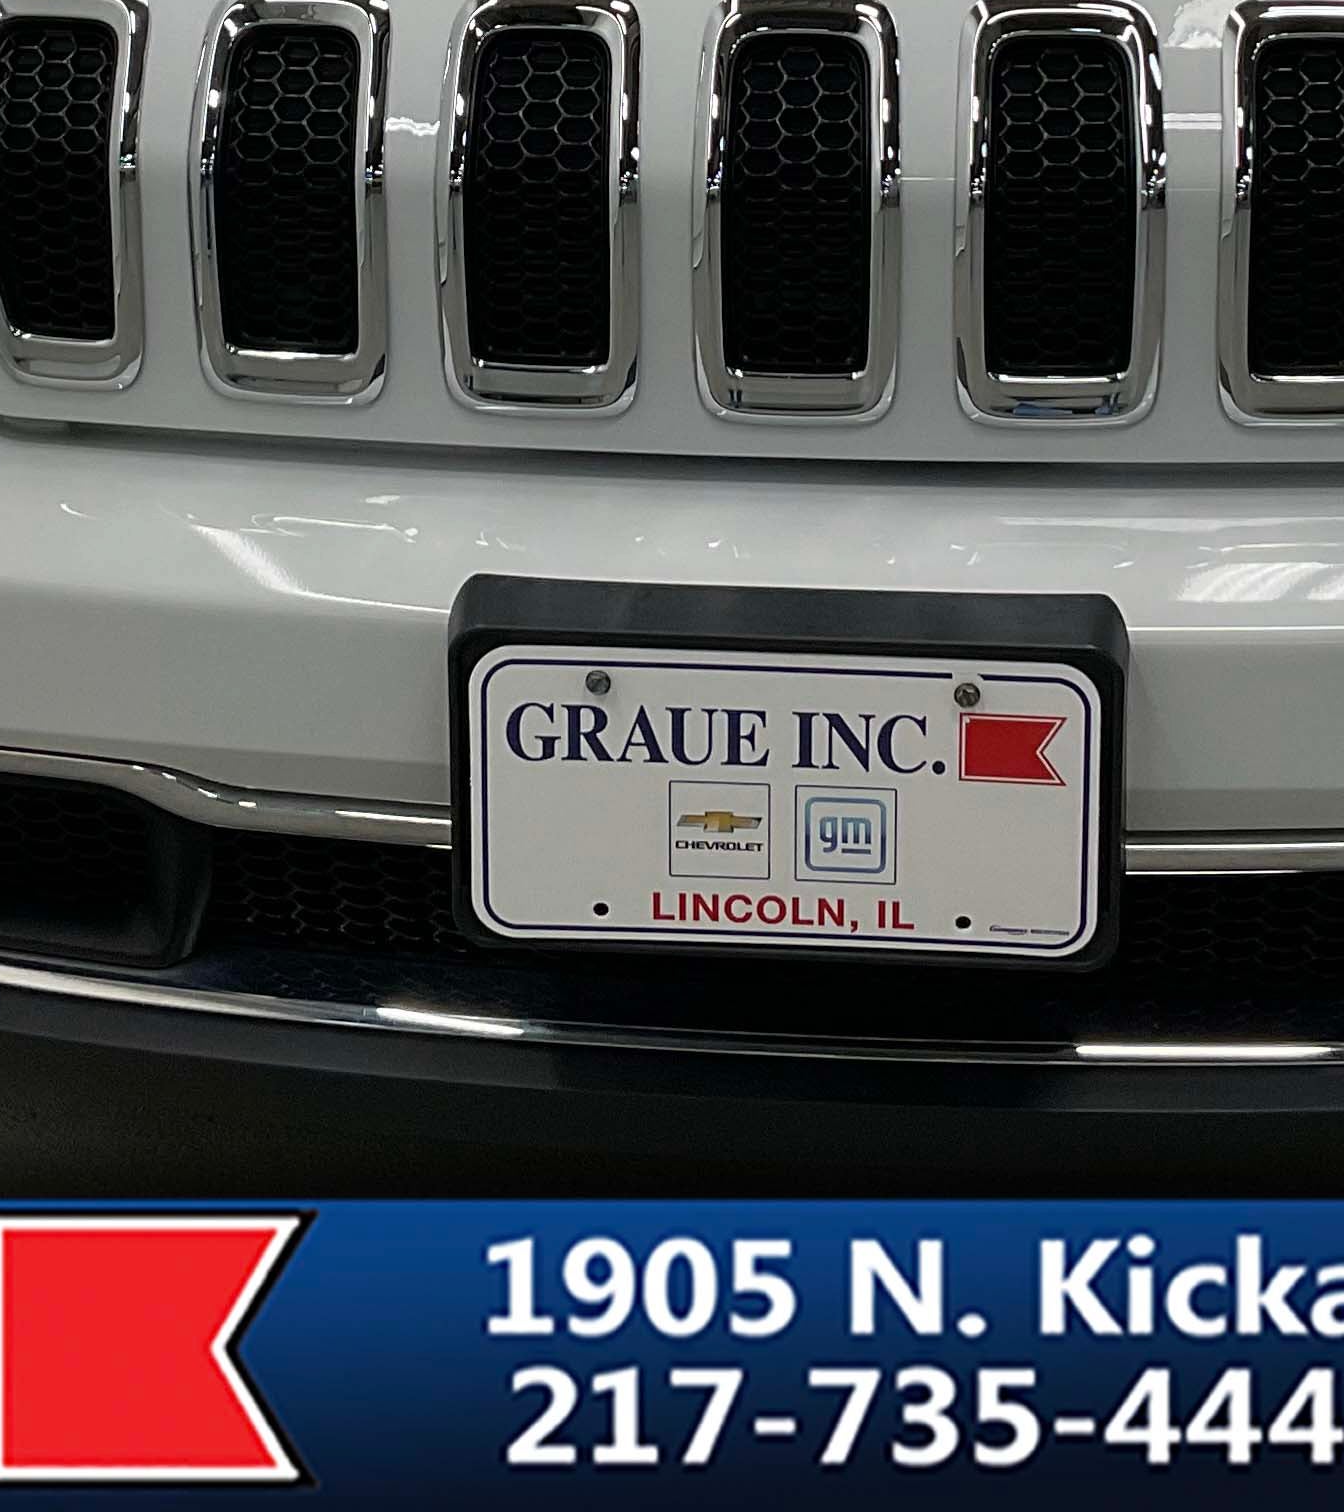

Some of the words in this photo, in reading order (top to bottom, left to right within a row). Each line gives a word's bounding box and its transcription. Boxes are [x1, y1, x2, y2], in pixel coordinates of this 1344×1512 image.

[505, 702, 770, 768] GRAUE
[791, 711, 947, 776] INC.
[674, 839, 765, 853] CHEVROLET
[819, 816, 873, 855] gm
[652, 892, 859, 932] LINCOLN,
[878, 900, 915, 930] IL
